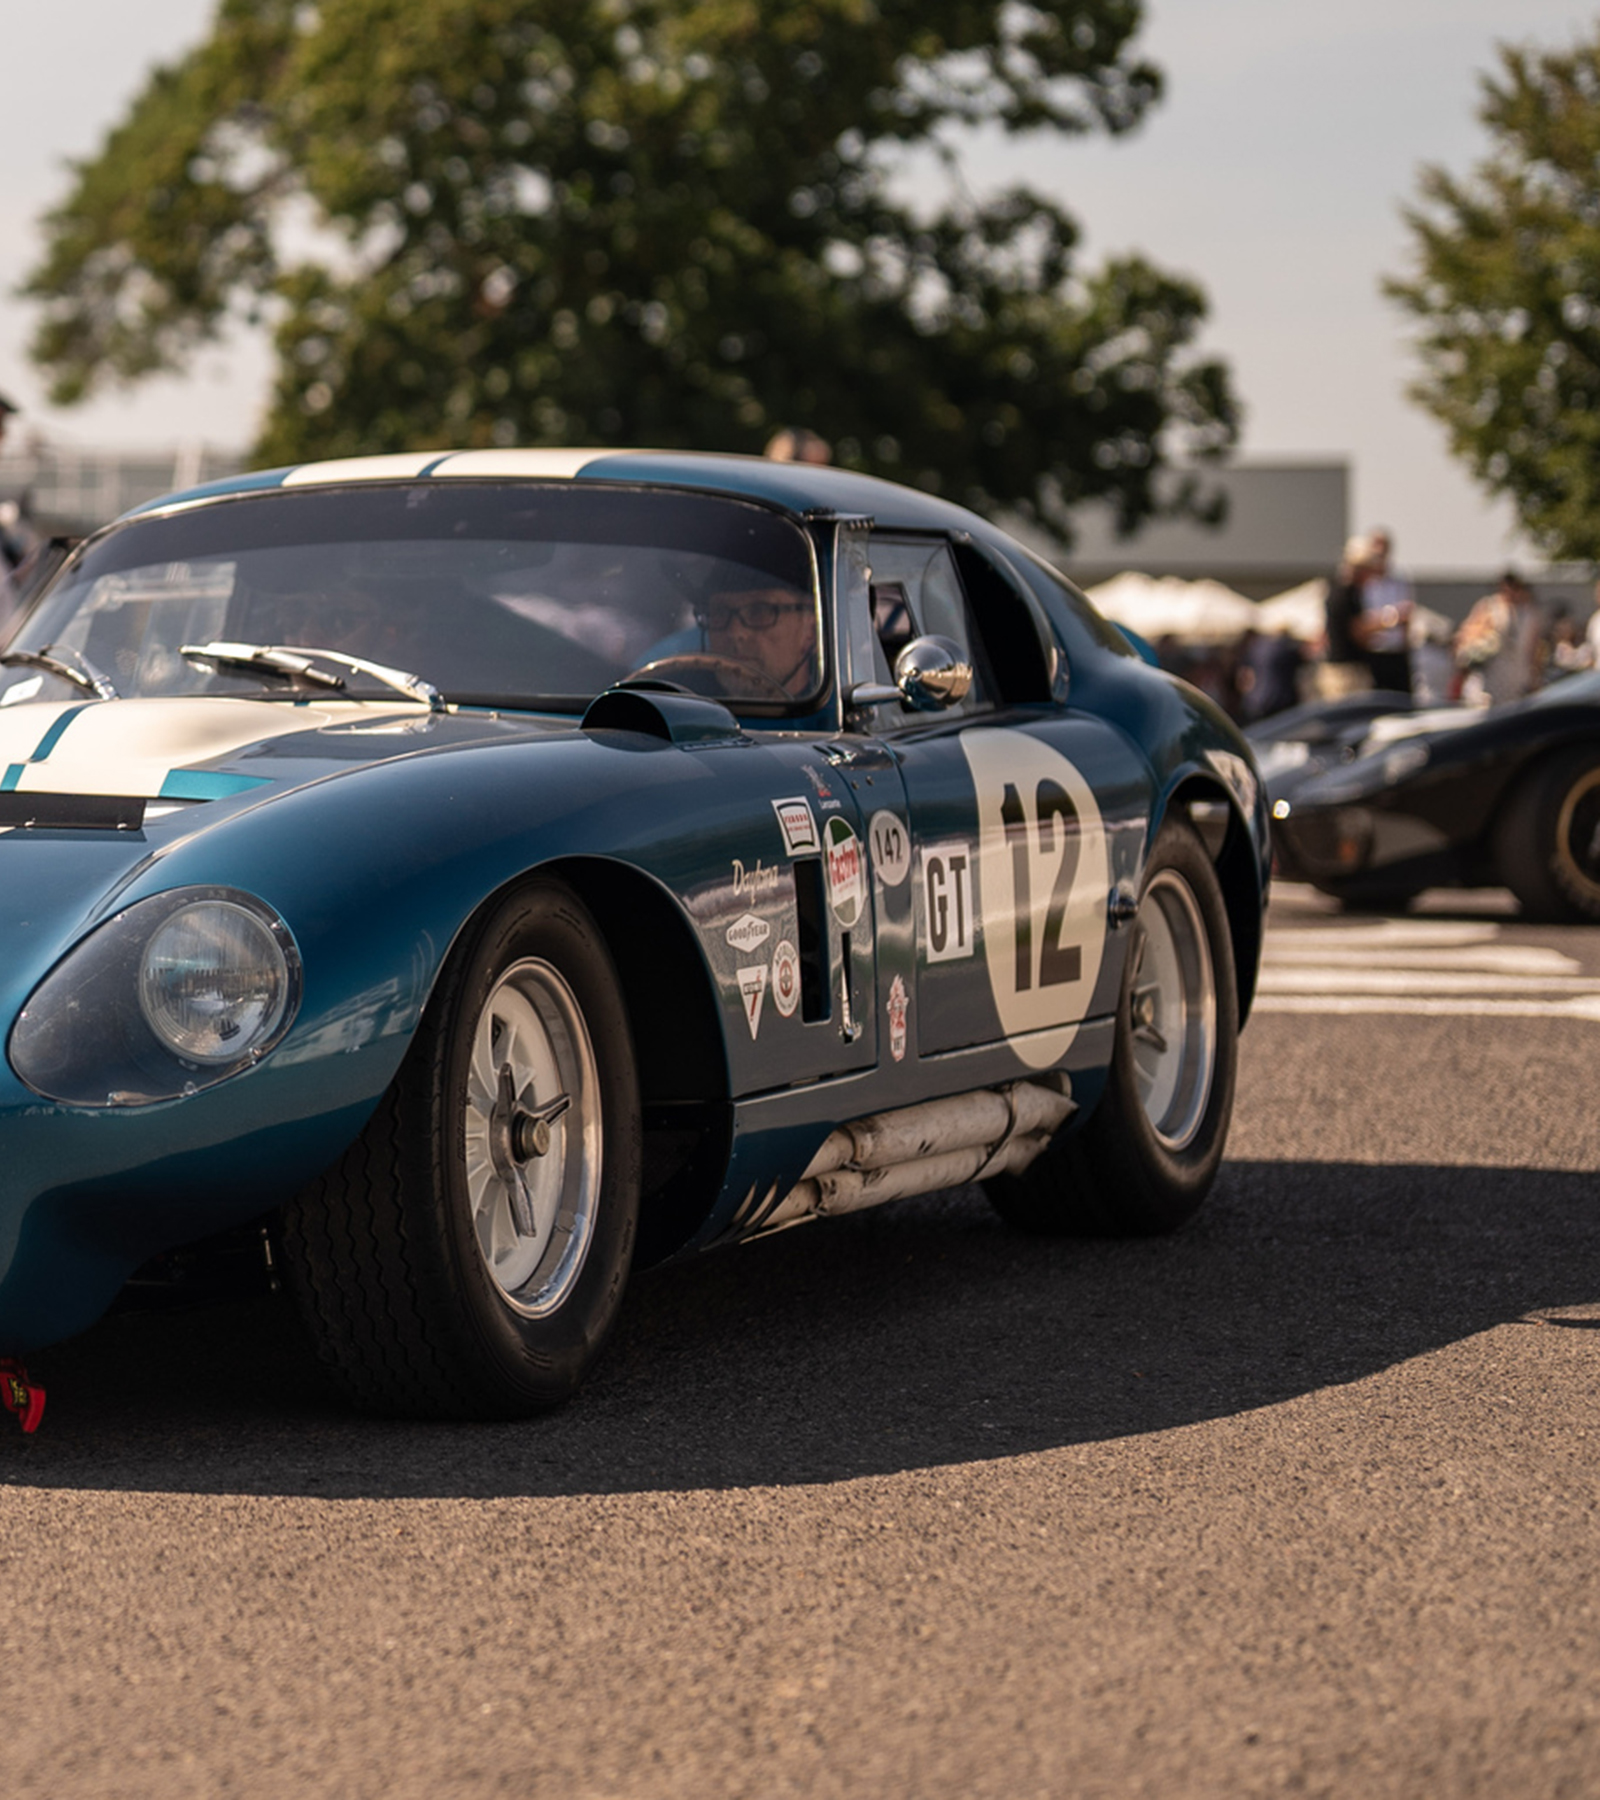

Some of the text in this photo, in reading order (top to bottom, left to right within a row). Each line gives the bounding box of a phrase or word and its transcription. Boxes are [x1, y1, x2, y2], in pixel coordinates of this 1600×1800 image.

[829, 838, 859, 887] Castrol
[875, 827, 903, 866] 142
[732, 858, 778, 905] Daytona
[926, 855, 966, 953] GT
[1000, 777, 1082, 993] 12
[728, 921, 768, 941] GOODYEAR
